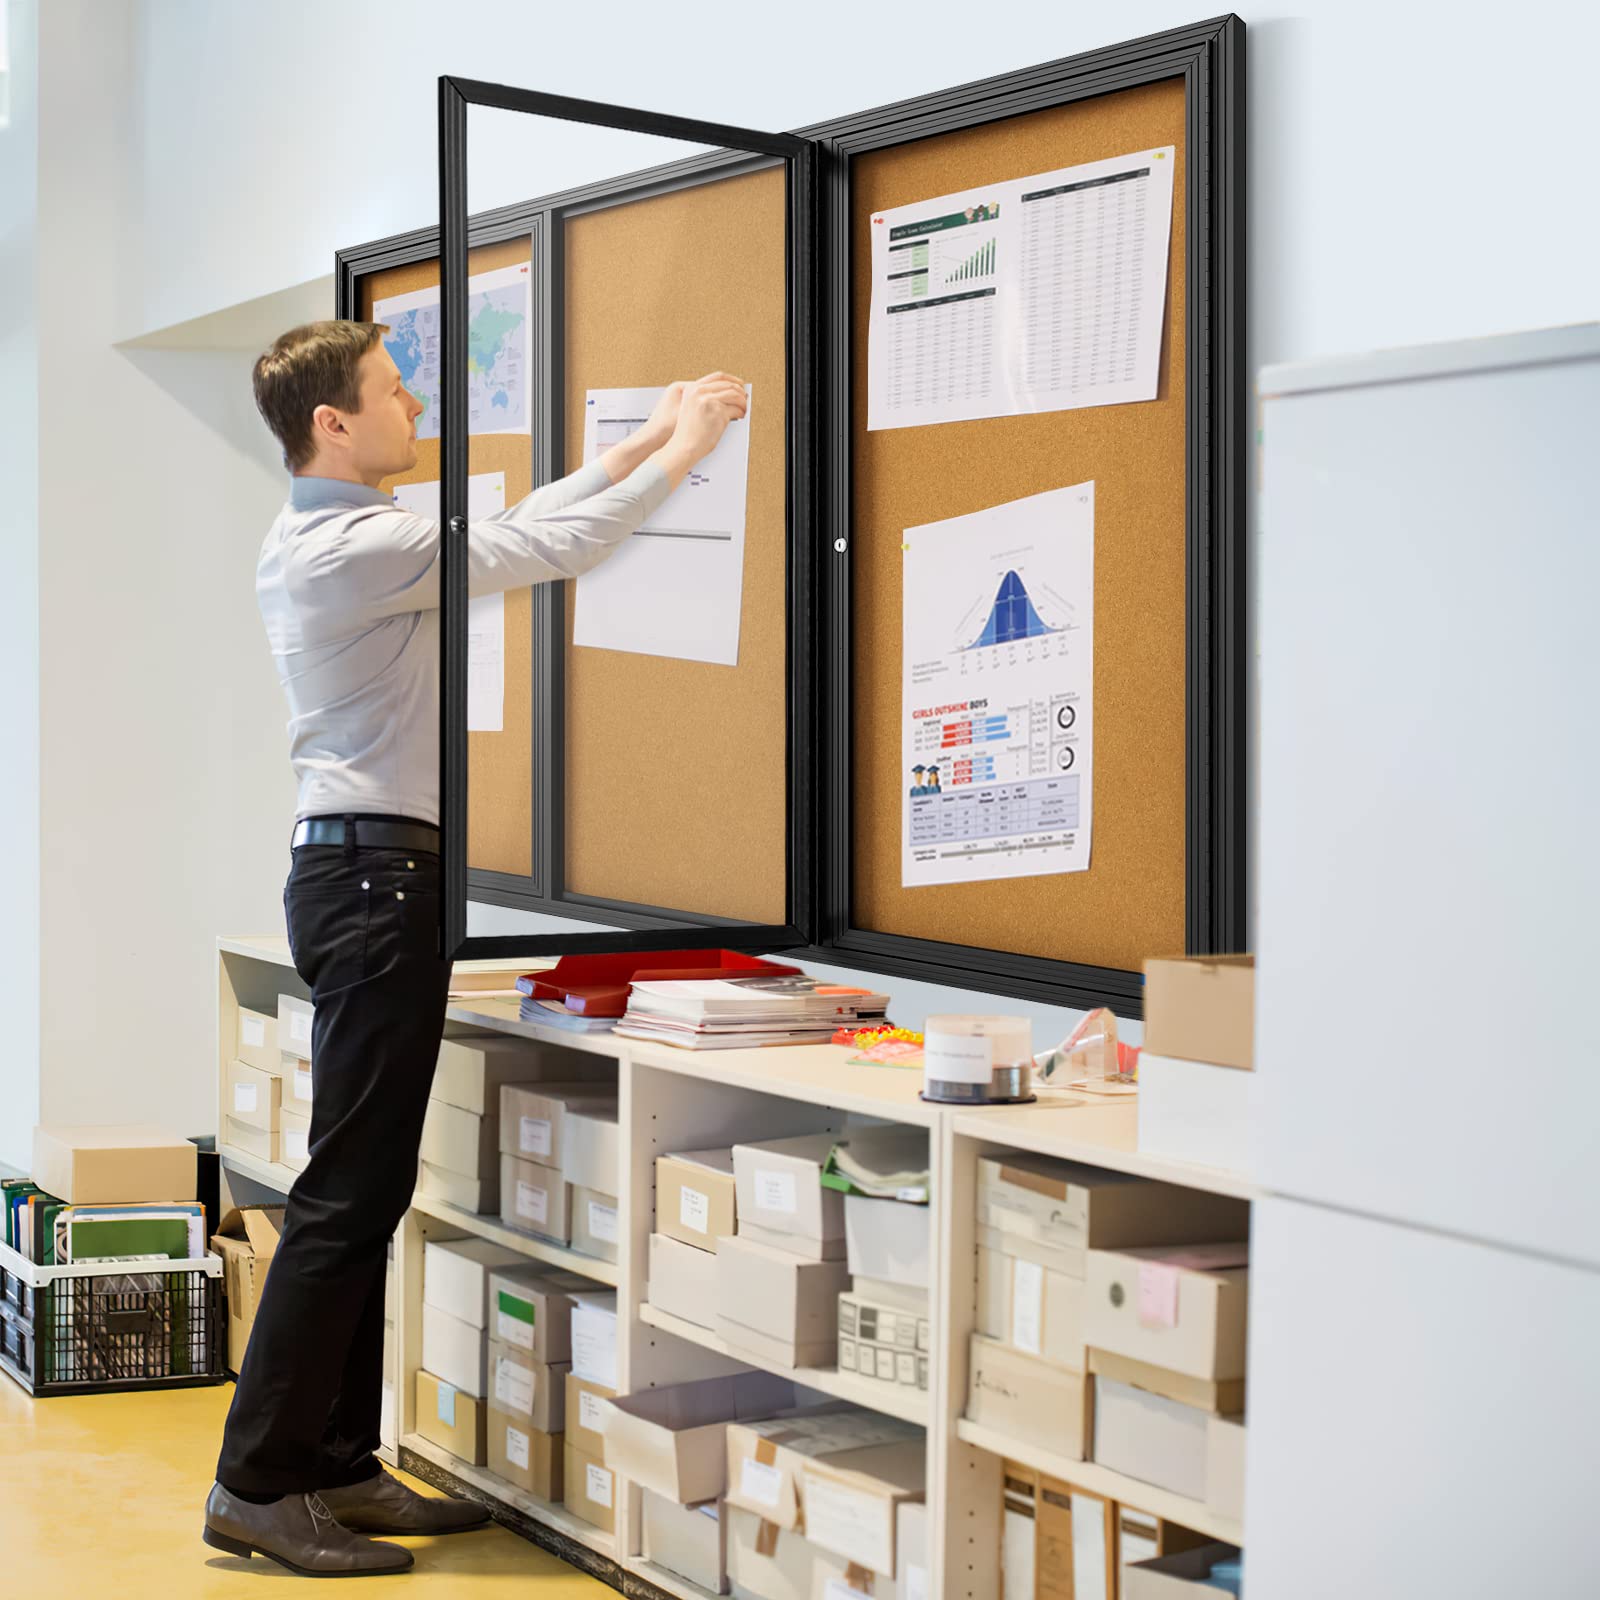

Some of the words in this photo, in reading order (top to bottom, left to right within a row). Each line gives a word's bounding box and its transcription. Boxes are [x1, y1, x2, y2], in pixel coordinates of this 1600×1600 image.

[912, 708, 933, 719] GIRLS
[935, 702, 968, 716] OUTSHINE
[969, 698, 988, 710] BOYS
